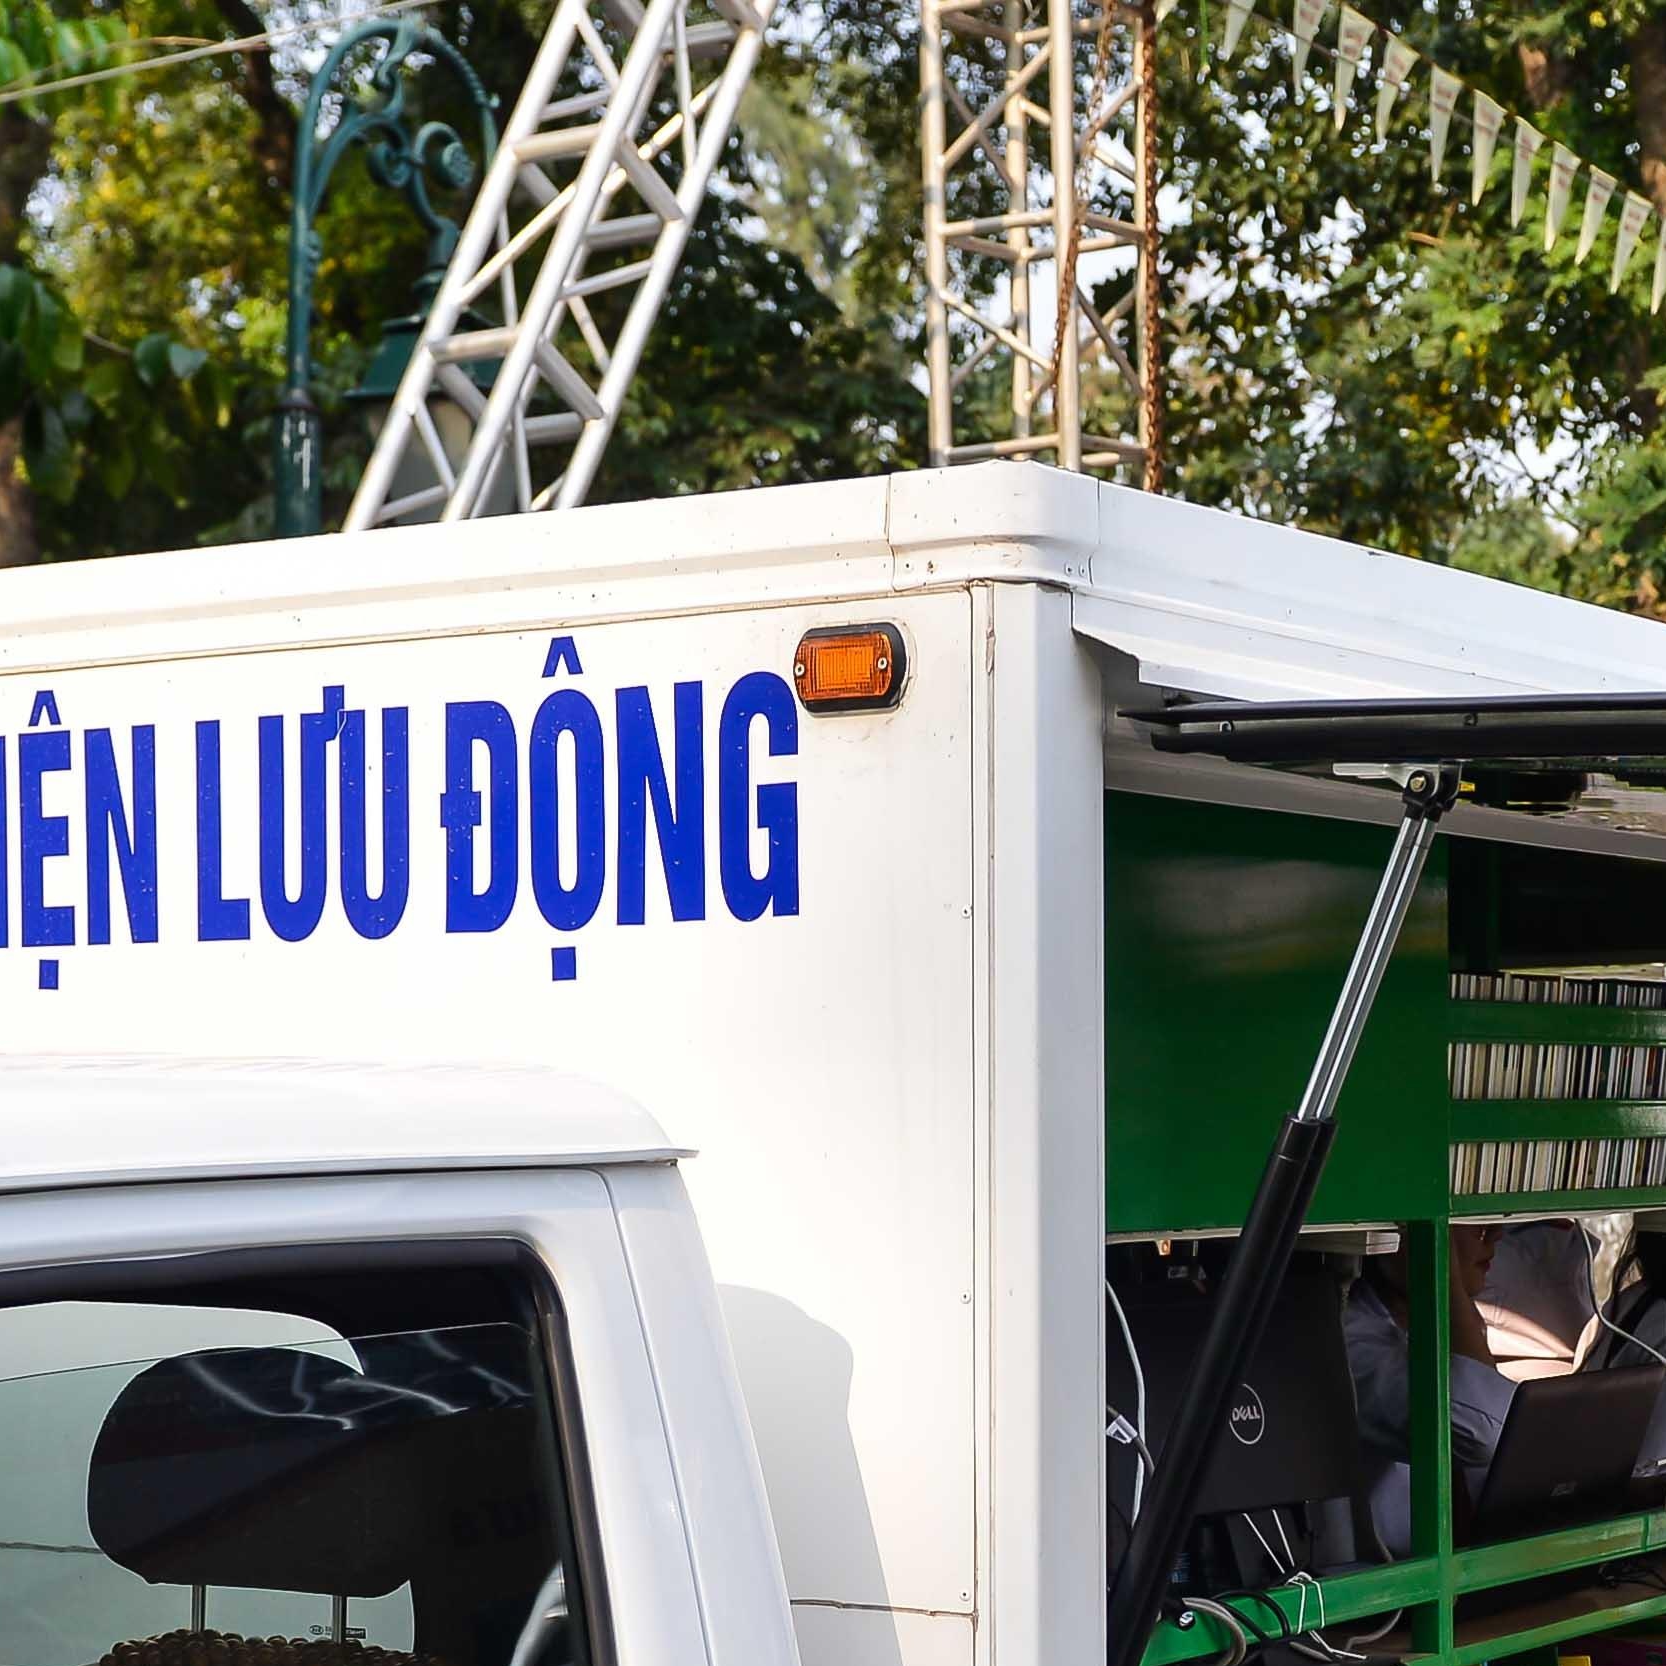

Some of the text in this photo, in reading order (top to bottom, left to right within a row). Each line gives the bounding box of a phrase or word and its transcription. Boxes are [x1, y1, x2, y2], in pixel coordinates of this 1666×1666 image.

[196, 685, 410, 942] LƯU
[440, 636, 799, 981] ĐỘNG
[1232, 1405, 1261, 1421] DELL
